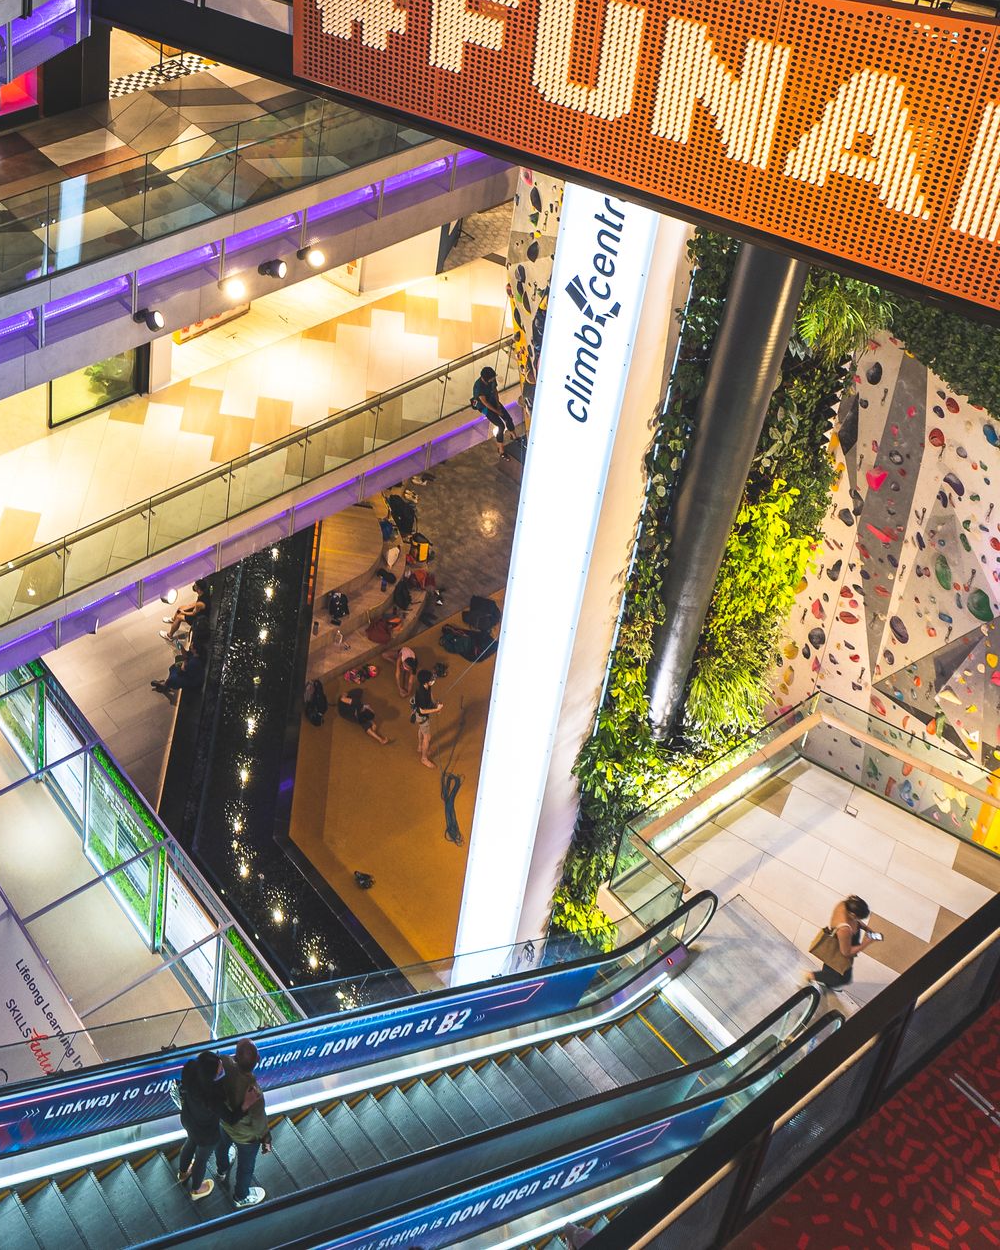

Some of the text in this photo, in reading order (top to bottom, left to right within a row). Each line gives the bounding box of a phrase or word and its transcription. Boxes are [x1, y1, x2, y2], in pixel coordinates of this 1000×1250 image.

[563, 320, 603, 424] climb
[15, 958, 45, 1006] Lifelong
[42, 1003, 76, 1058] Learning
[303, 1044, 317, 1058] is
[318, 1032, 366, 1058] now
[365, 1020, 414, 1048] open
[415, 1016, 437, 1034] at
[434, 1007, 473, 1036] B2
[44, 1091, 122, 1120] Linkway
[122, 1086, 140, 1101] to
[377, 1157, 599, 1250] station is now open at B2
